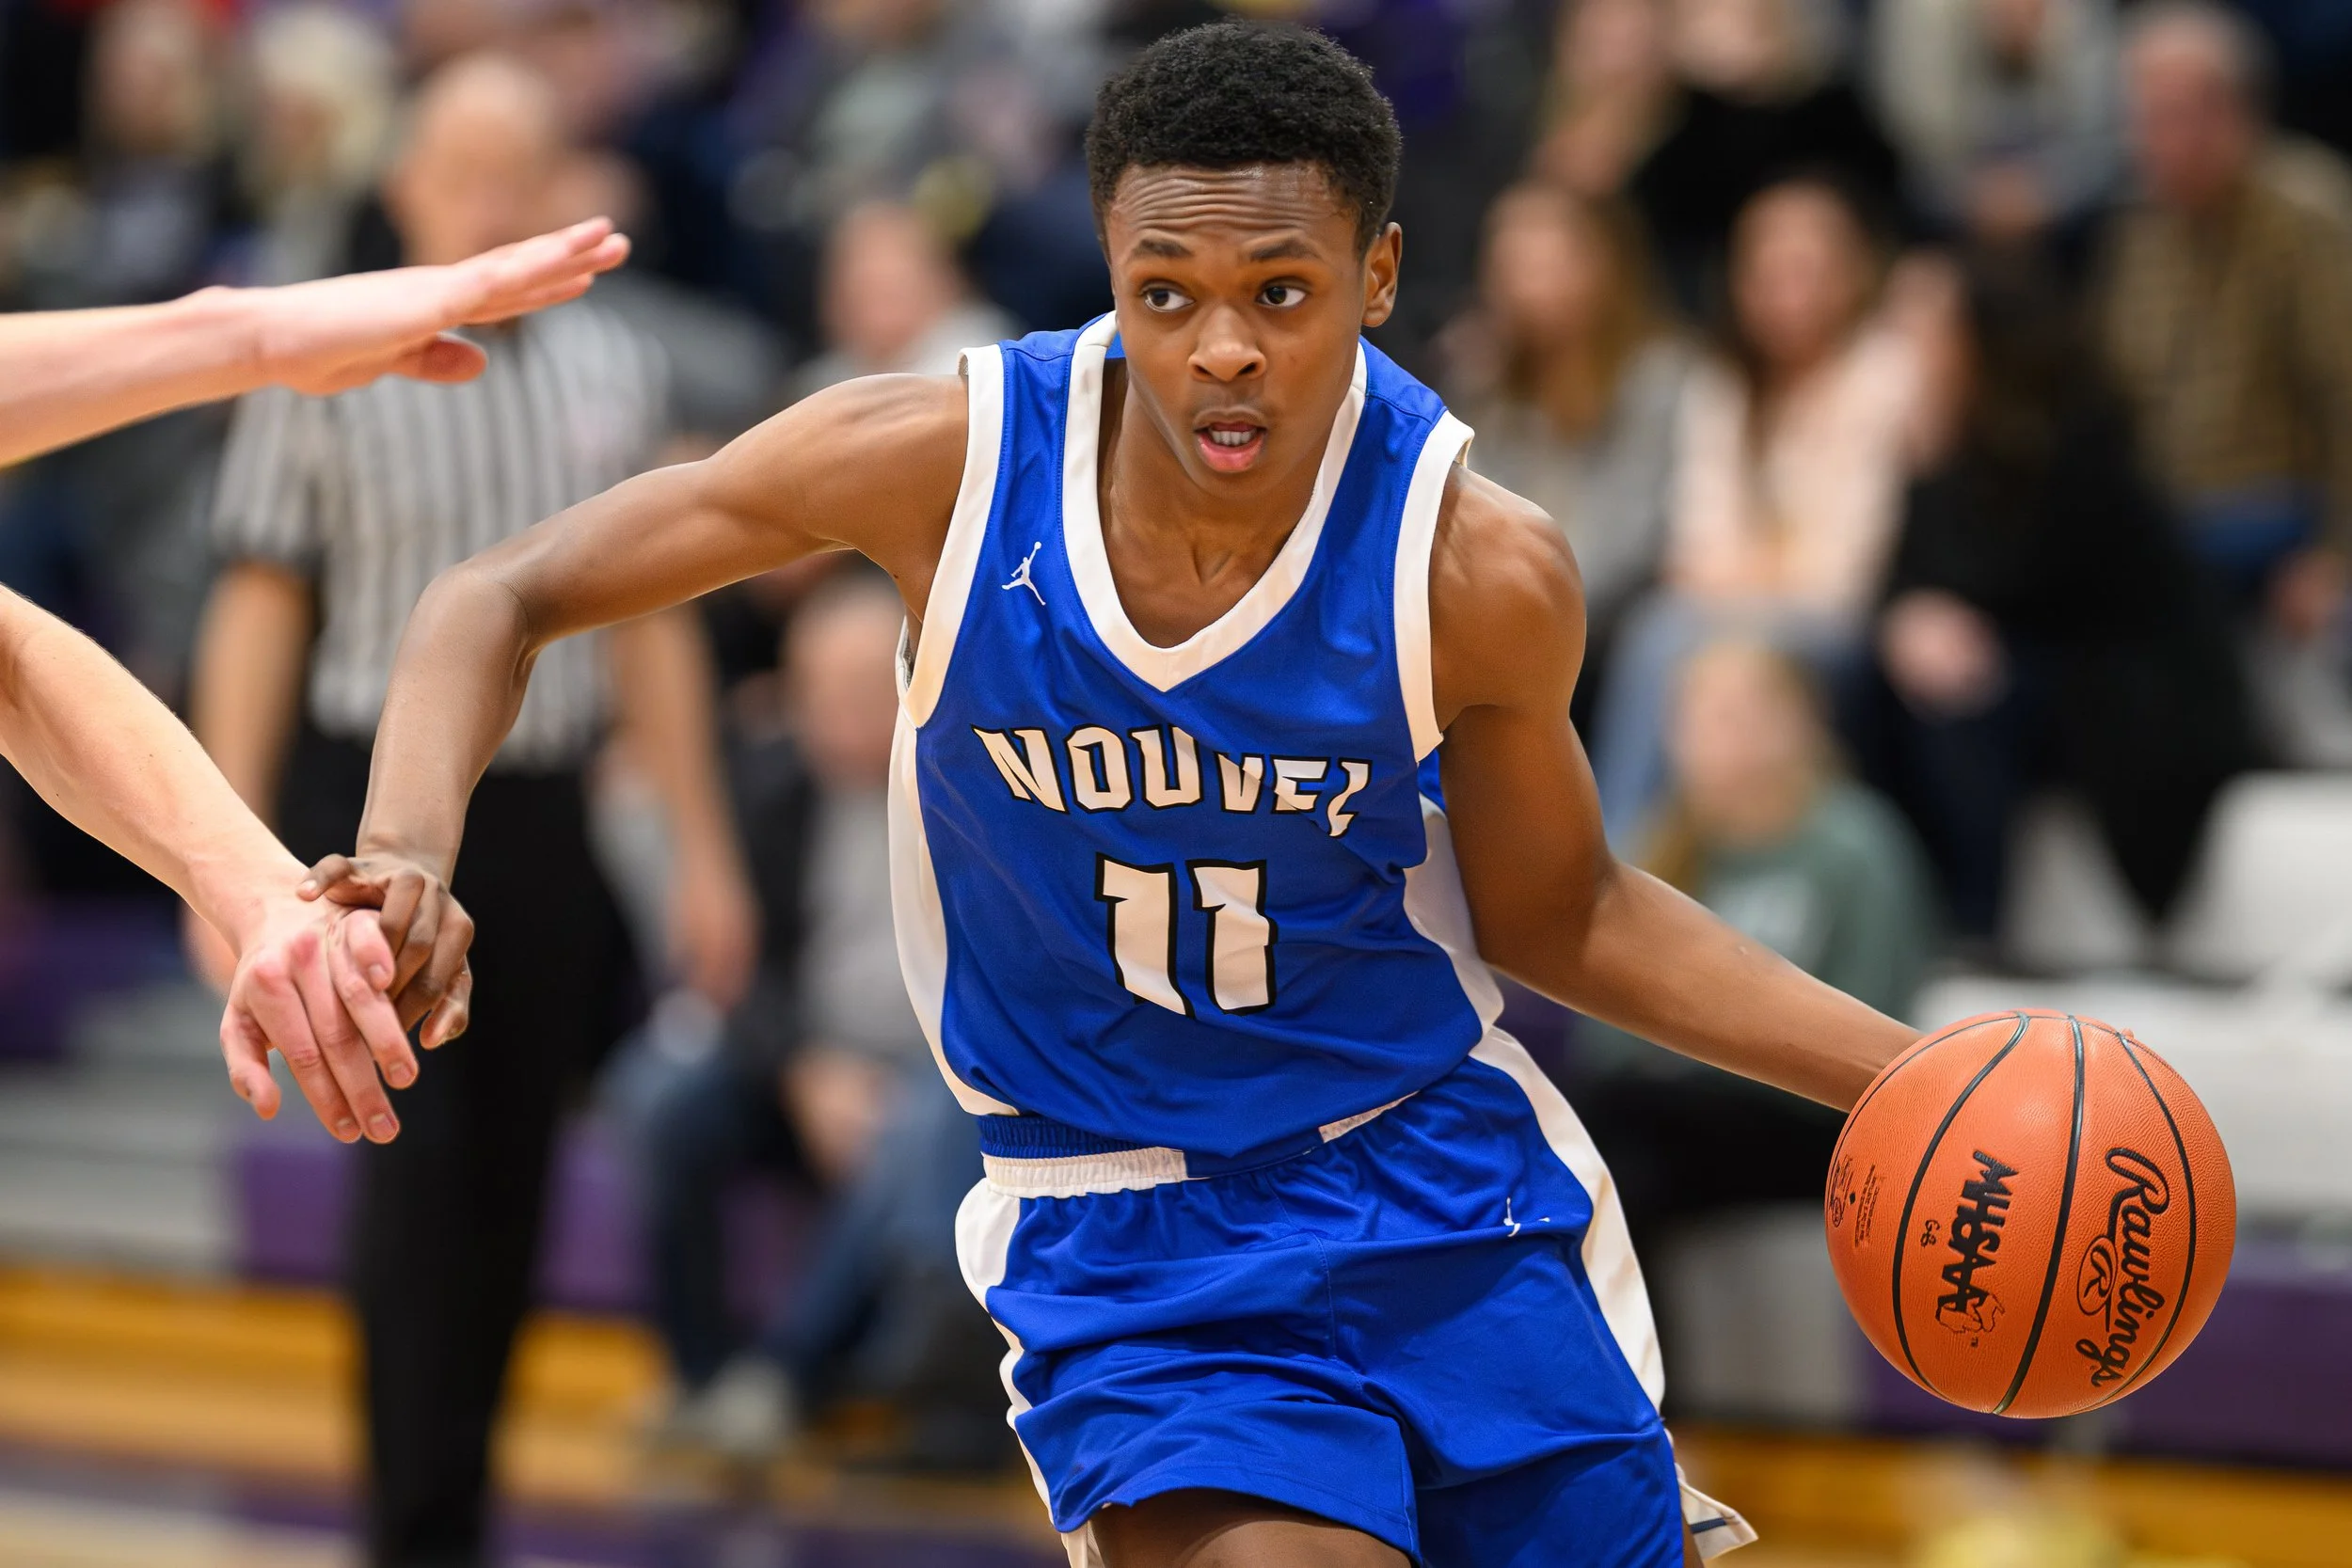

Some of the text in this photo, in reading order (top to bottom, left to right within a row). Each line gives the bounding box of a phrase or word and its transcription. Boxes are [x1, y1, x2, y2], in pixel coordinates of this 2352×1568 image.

[1095, 852, 1277, 1020] 11
[1938, 1150, 2019, 1314] MHSAA
[2075, 1148, 2169, 1387] Rawlings
